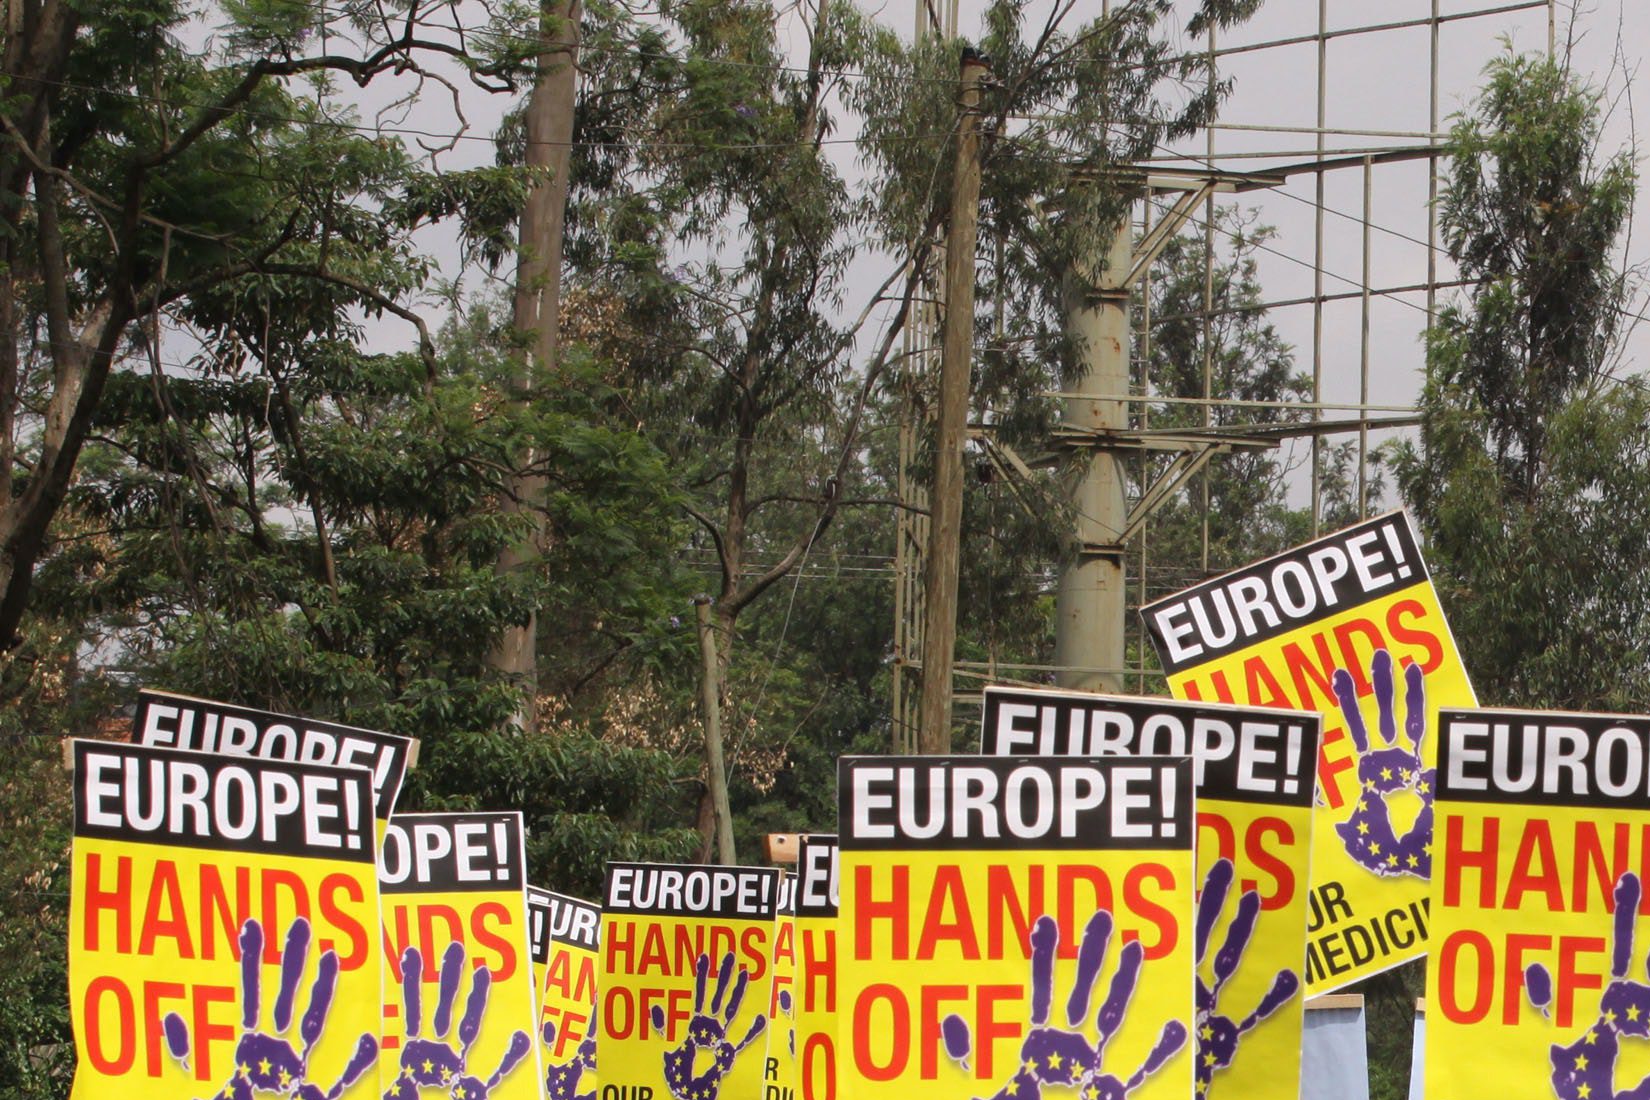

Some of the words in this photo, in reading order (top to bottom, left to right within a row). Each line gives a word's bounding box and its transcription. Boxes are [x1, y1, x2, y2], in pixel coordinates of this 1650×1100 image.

[1154, 524, 1412, 665] EUROPE!
[996, 703, 1302, 794] EUROPE!
[86, 754, 364, 849] EUROPE!
[853, 766, 1178, 839] EUROPE!
[379, 823, 510, 884] OPE!
[610, 869, 771, 914] EUROPE!
[84, 853, 369, 971] HANDS
[382, 902, 517, 984] NDS
[605, 921, 767, 981] HANDS
[854, 864, 1178, 961] HANDS
[1308, 881, 1354, 931] UR
[603, 986, 691, 1041] OFF
[1437, 929, 1606, 1029] OFF
[85, 976, 236, 1081] OFF
[853, 983, 1024, 1082] OFF
